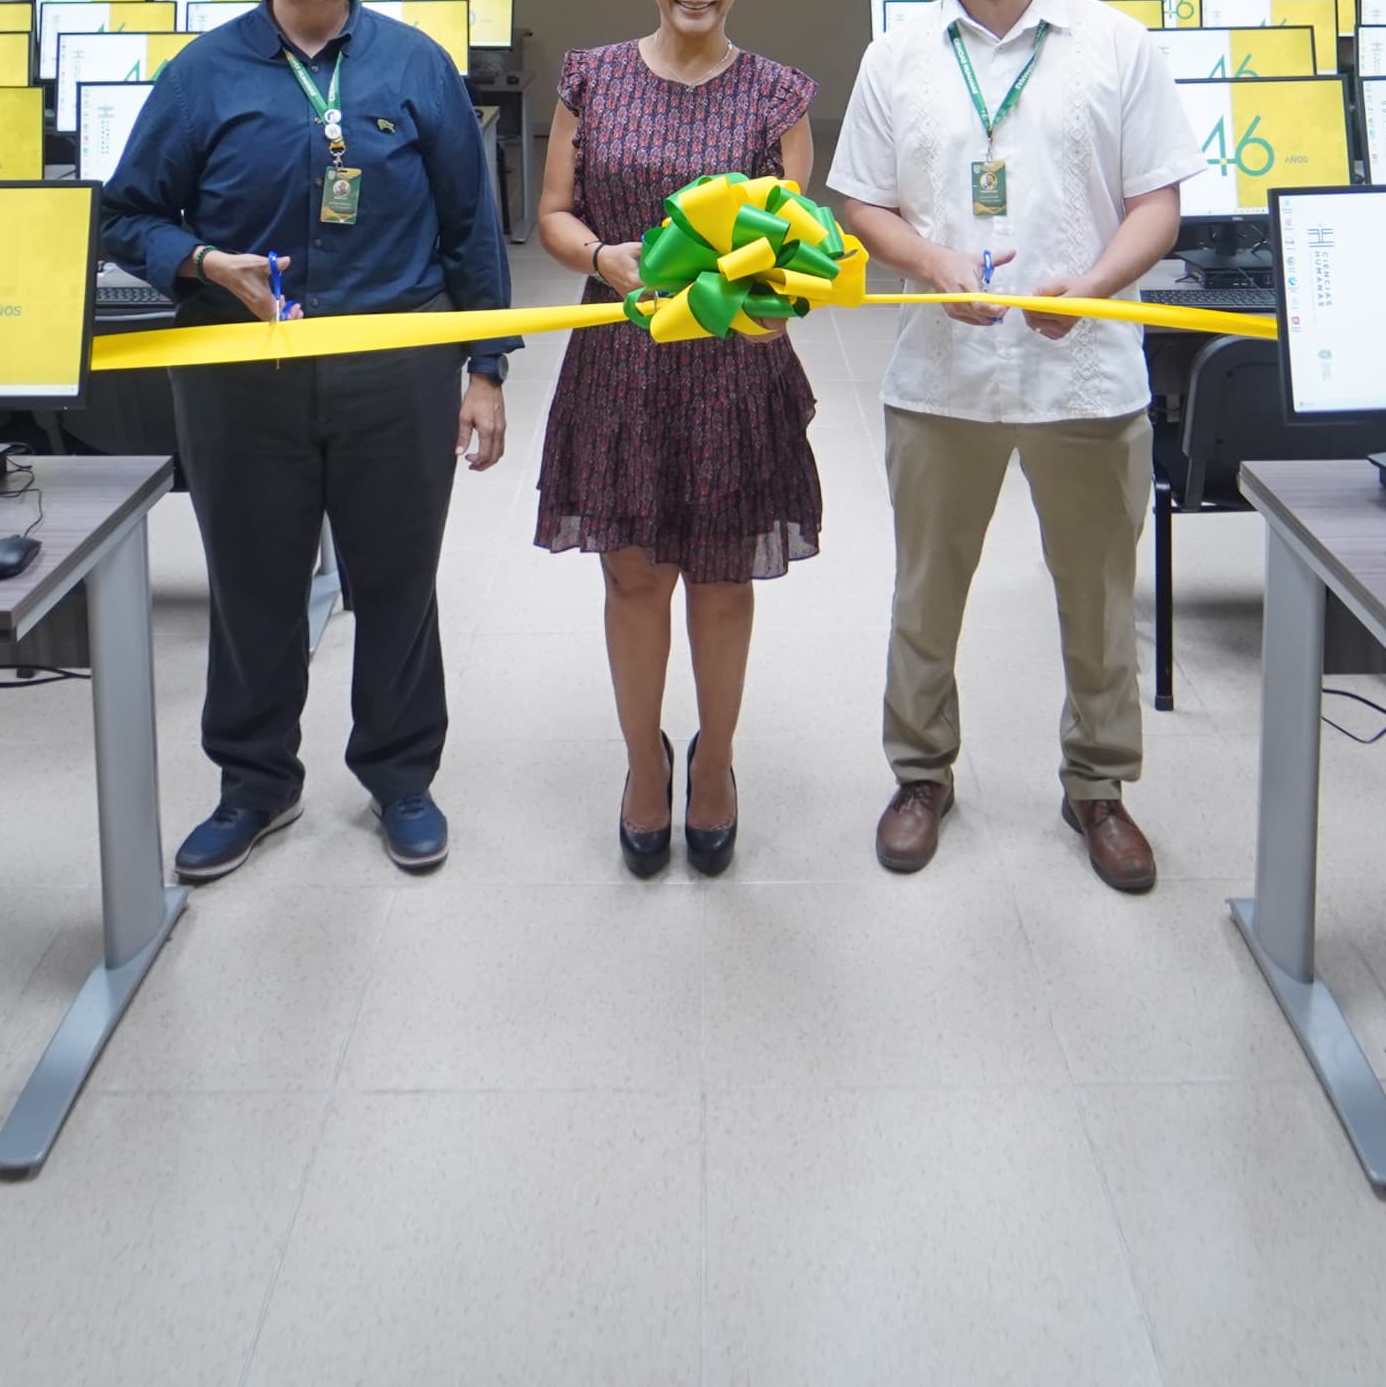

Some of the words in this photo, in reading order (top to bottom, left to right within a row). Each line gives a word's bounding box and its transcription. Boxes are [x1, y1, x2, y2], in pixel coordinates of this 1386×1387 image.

[1201, 115, 1275, 177] 46
[1314, 250, 1325, 308] HUMANAS
[1321, 250, 1333, 307] CIENCIAS
